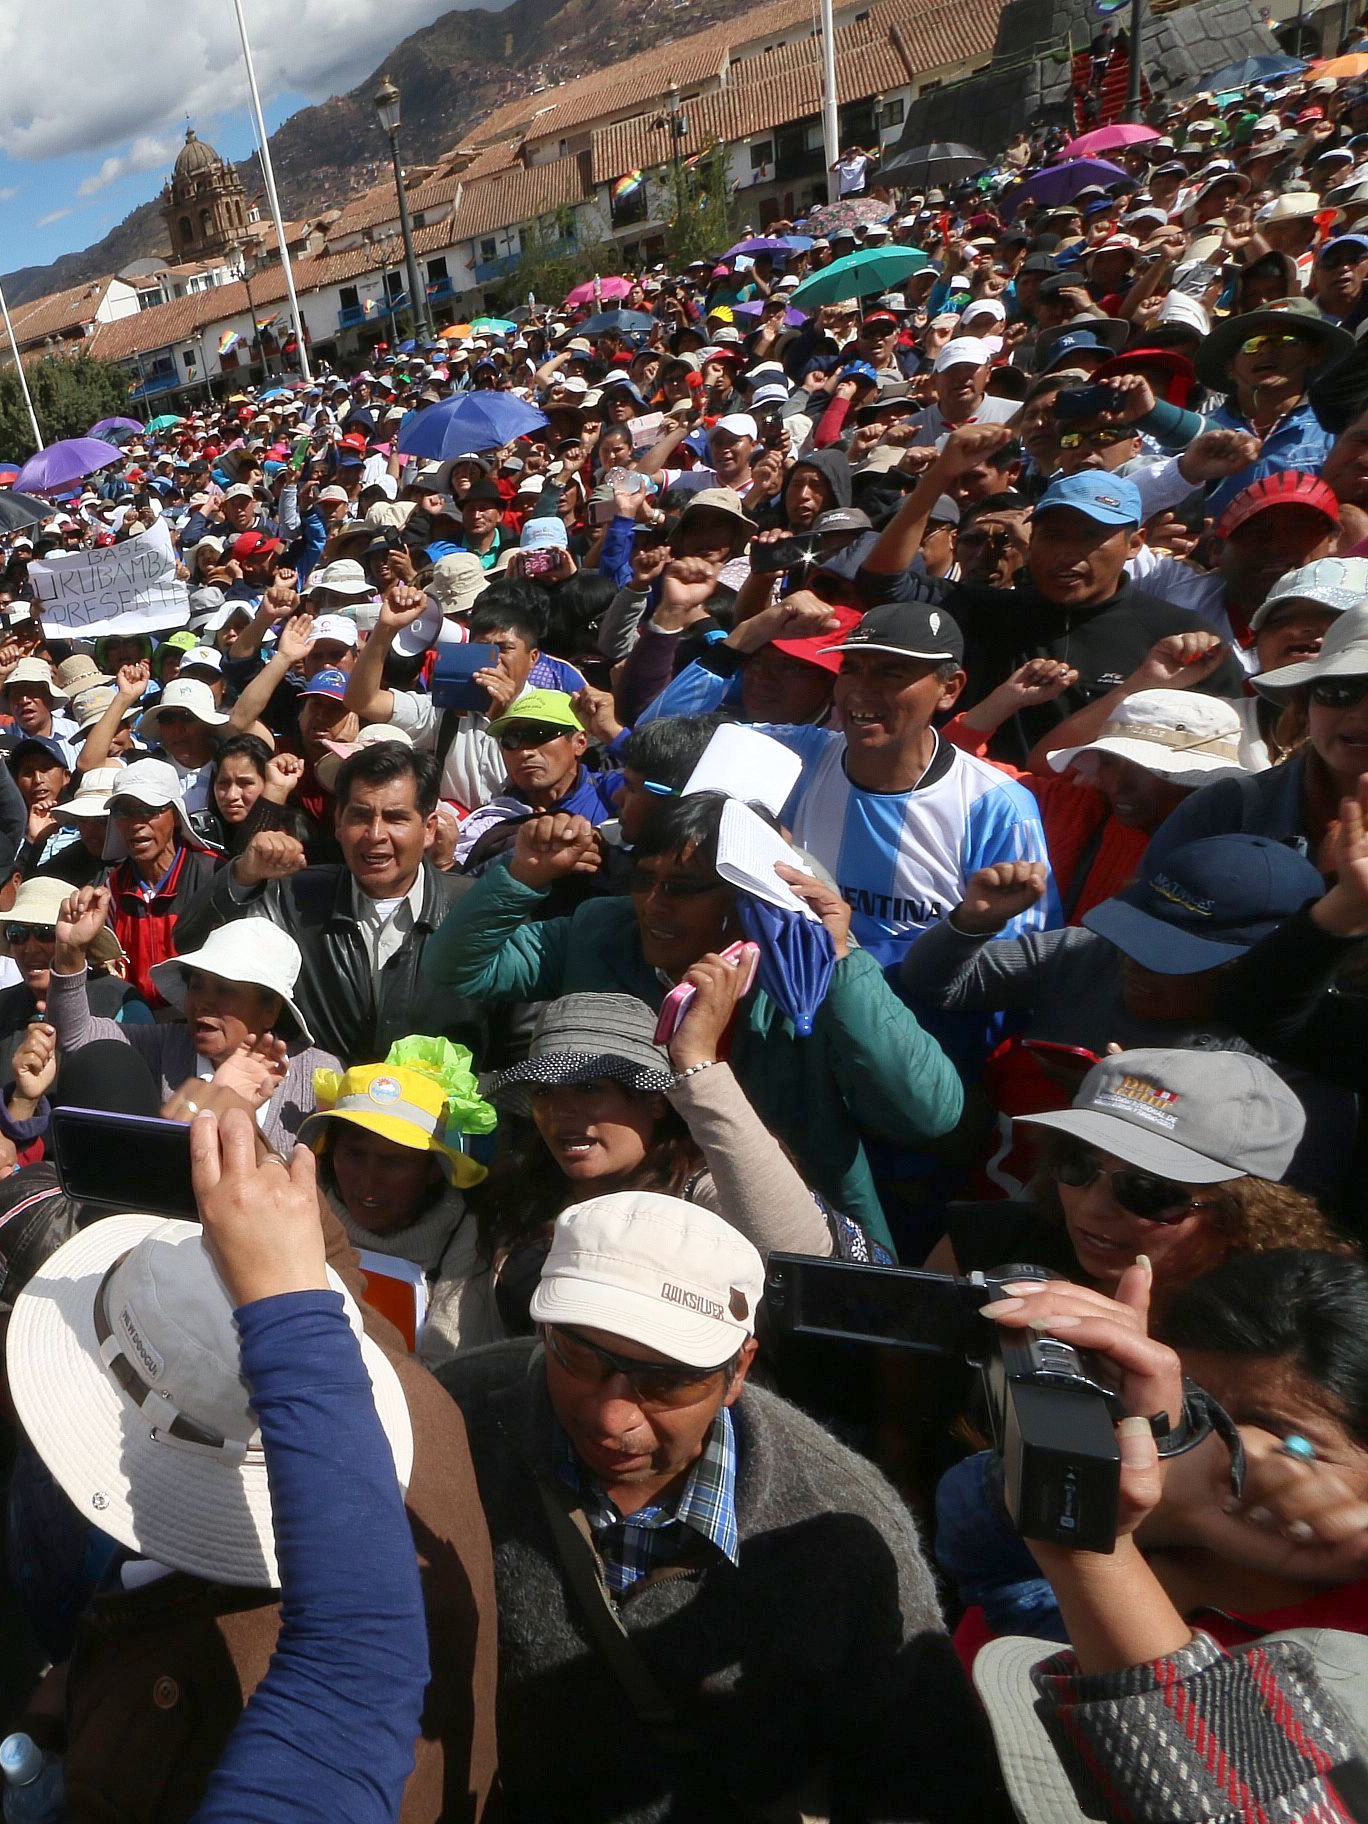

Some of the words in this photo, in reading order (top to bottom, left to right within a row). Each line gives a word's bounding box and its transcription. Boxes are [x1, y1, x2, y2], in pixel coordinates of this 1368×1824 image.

[87, 537, 149, 566] BASE
[48, 580, 189, 634] PRESENTE
[839, 885, 942, 922] ENTINA
[661, 1282, 724, 1321] QUIKSILVER
